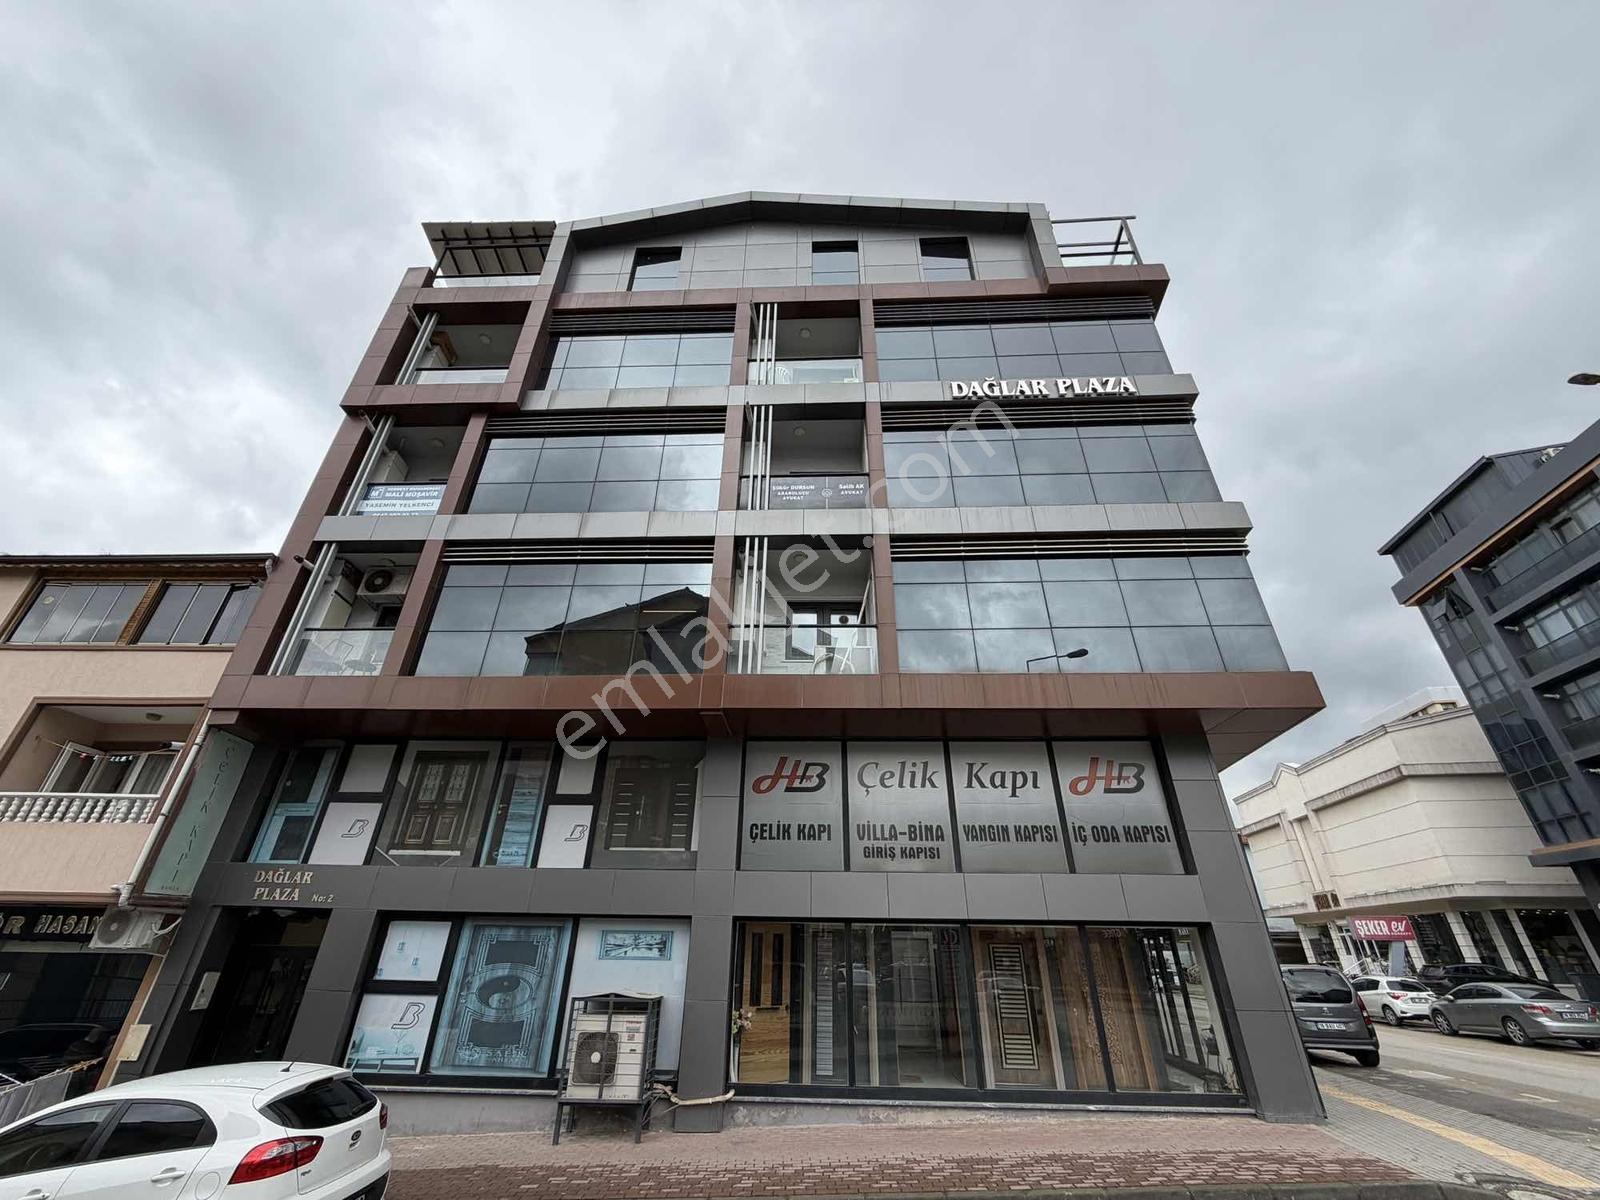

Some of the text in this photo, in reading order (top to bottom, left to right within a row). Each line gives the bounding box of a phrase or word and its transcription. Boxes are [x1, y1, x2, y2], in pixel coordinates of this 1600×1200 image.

[950, 377, 1137, 397] DAĞLAR PLAZA
[857, 761, 1041, 797] Çelik Kapı
[750, 821, 832, 843] ÇELİK KAPI
[857, 821, 945, 842] VİLLA-BİNA
[963, 824, 1058, 843] YANGIN KAPISI
[1072, 822, 1171, 846] İÇ ODA KAPISI
[863, 845, 940, 861] GİRİŞ KAPISI
[254, 867, 314, 884] DAĞLAR
[253, 887, 300, 901] PLAZA
[1354, 919, 1391, 938] ŞEKER
